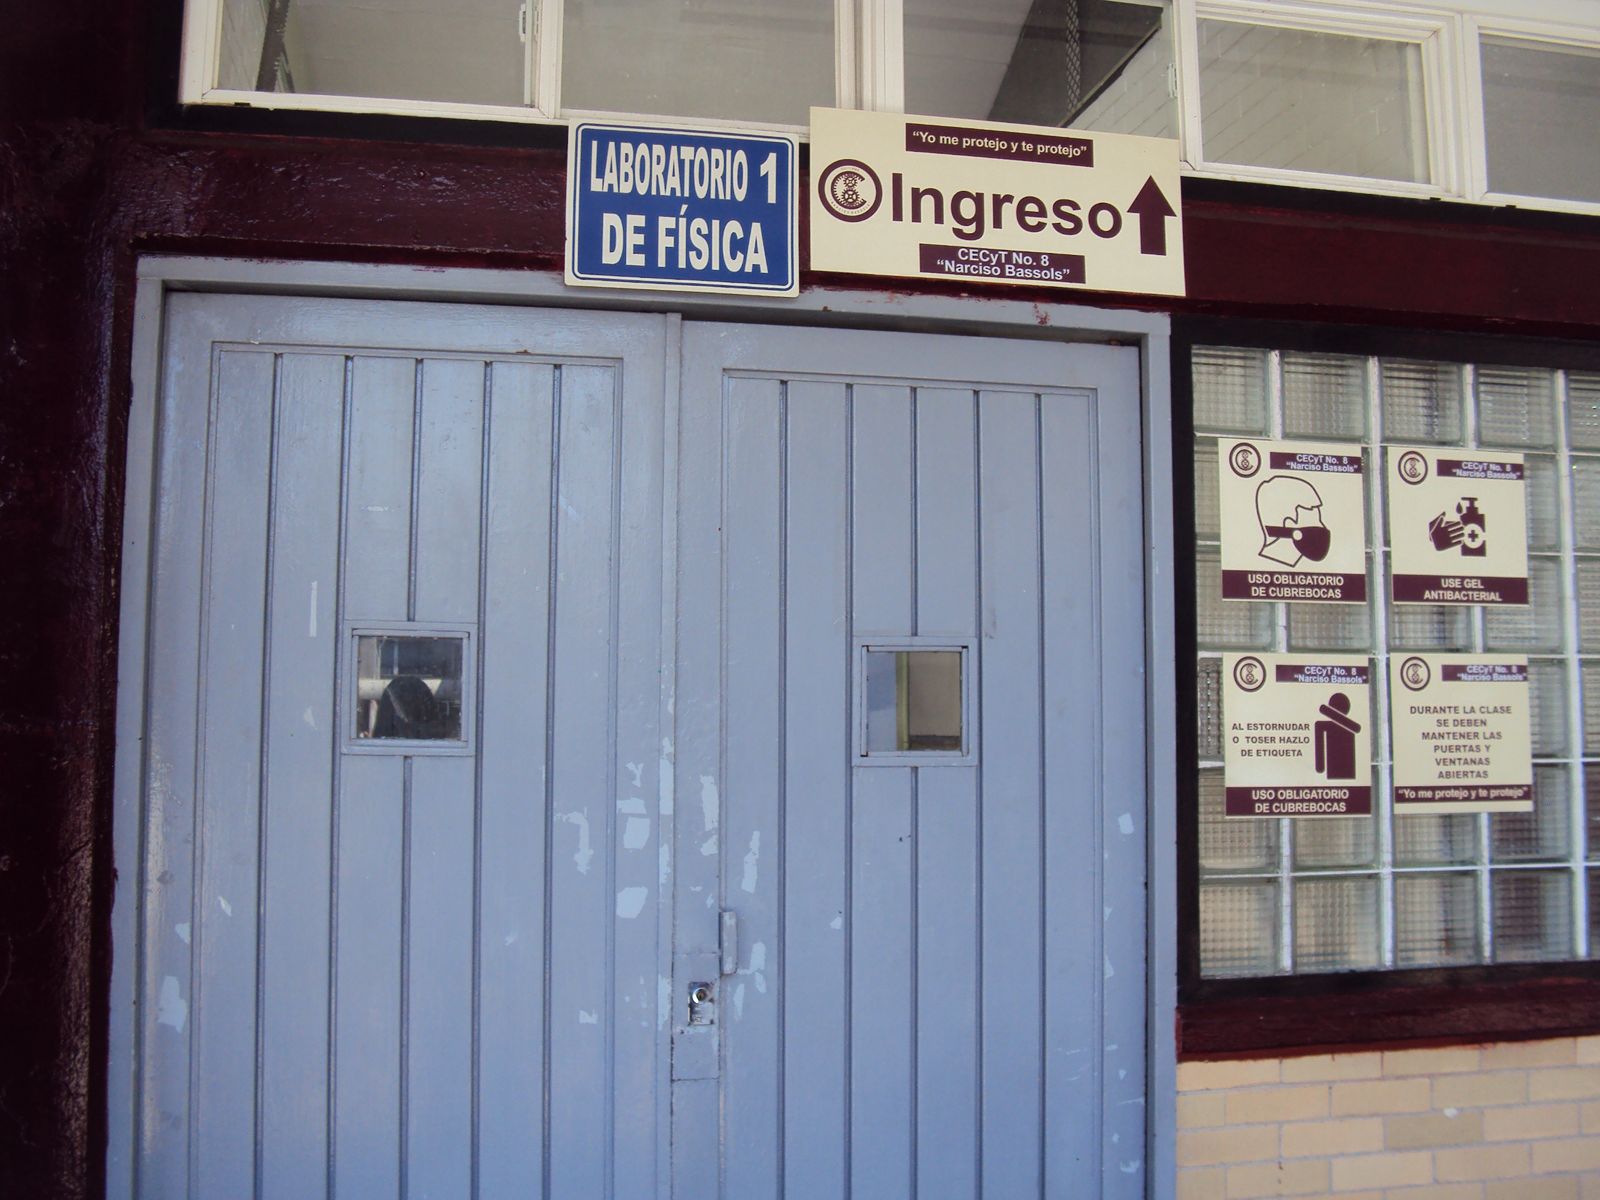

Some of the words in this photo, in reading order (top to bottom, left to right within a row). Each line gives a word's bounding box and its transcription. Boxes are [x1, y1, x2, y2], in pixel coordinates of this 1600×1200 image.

[912, 130, 936, 144] “Yo
[939, 135, 959, 146] me
[962, 136, 1008, 152] protejo
[1010, 141, 1019, 153] y
[1022, 141, 1034, 152] te
[1037, 143, 1087, 159] protejo”
[590, 140, 748, 202] LABORATORIO
[760, 152, 777, 204] 1
[891, 172, 1123, 241] Ingreso
[602, 213, 646, 267] DE
[658, 204, 769, 274] FÍSICA
[957, 248, 1009, 266] CECyT
[1012, 252, 1037, 266] No.
[1040, 254, 1050, 267] 8
[936, 259, 1001, 276] “Narciso
[1005, 264, 1070, 280] Bassols”
[1296, 454, 1324, 465] CECyT
[1325, 455, 1339, 465] No.
[1342, 456, 1349, 465] 8
[1286, 461, 1321, 472] “Narciso
[1322, 463, 1358, 473] Bassols”
[1461, 461, 1489, 471] CECyT
[1489, 463, 1503, 472] No.
[1248, 574, 1271, 585] USO
[1273, 574, 1344, 586] OBLIGATORIO
[1441, 578, 1462, 588] USE
[1463, 578, 1484, 589] GEL
[1251, 587, 1267, 597] DE
[1269, 587, 1342, 599] CUBREBOCAS
[1423, 590, 1503, 602] ANTIBACTERIAL
[1304, 666, 1332, 677] CECyT
[1333, 667, 1348, 676] No.
[1351, 667, 1357, 676] 8
[1466, 665, 1493, 675] CECyT
[1294, 674, 1330, 683] “Narciso
[1331, 675, 1367, 684] Bassols”
[1409, 705, 1460, 715] DURANTE
[1463, 706, 1477, 714] LA
[1479, 706, 1513, 715] CLASE
[1232, 723, 1245, 731] AL
[1246, 723, 1311, 732] ESTORNUDAR
[1436, 719, 1450, 728] SE
[1452, 719, 1487, 728] DEBEN
[1232, 736, 1240, 745] O
[1245, 736, 1277, 745] TOSER
[1279, 736, 1310, 745] HAZLO
[1421, 731, 1480, 741] MANTENER
[1482, 731, 1503, 740] LAS
[1240, 749, 1254, 758] DE
[1256, 749, 1303, 758] ETIQUETA
[1433, 744, 1482, 754] PUERTAS
[1484, 745, 1491, 753] Y
[1435, 757, 1491, 767] VENTANAS
[1437, 770, 1489, 780] ABIERTAS
[1252, 790, 1275, 801] USO
[1277, 789, 1349, 800] OBLIGATORIO
[1398, 788, 1415, 799] “Yo
[1418, 790, 1432, 799] me
[1435, 788, 1469, 801] protejo
[1470, 790, 1477, 800] y
[1478, 788, 1488, 798] te
[1490, 787, 1528, 800] protejo”
[1255, 803, 1270, 814] DE
[1272, 802, 1347, 814] CUBREBOCAS
